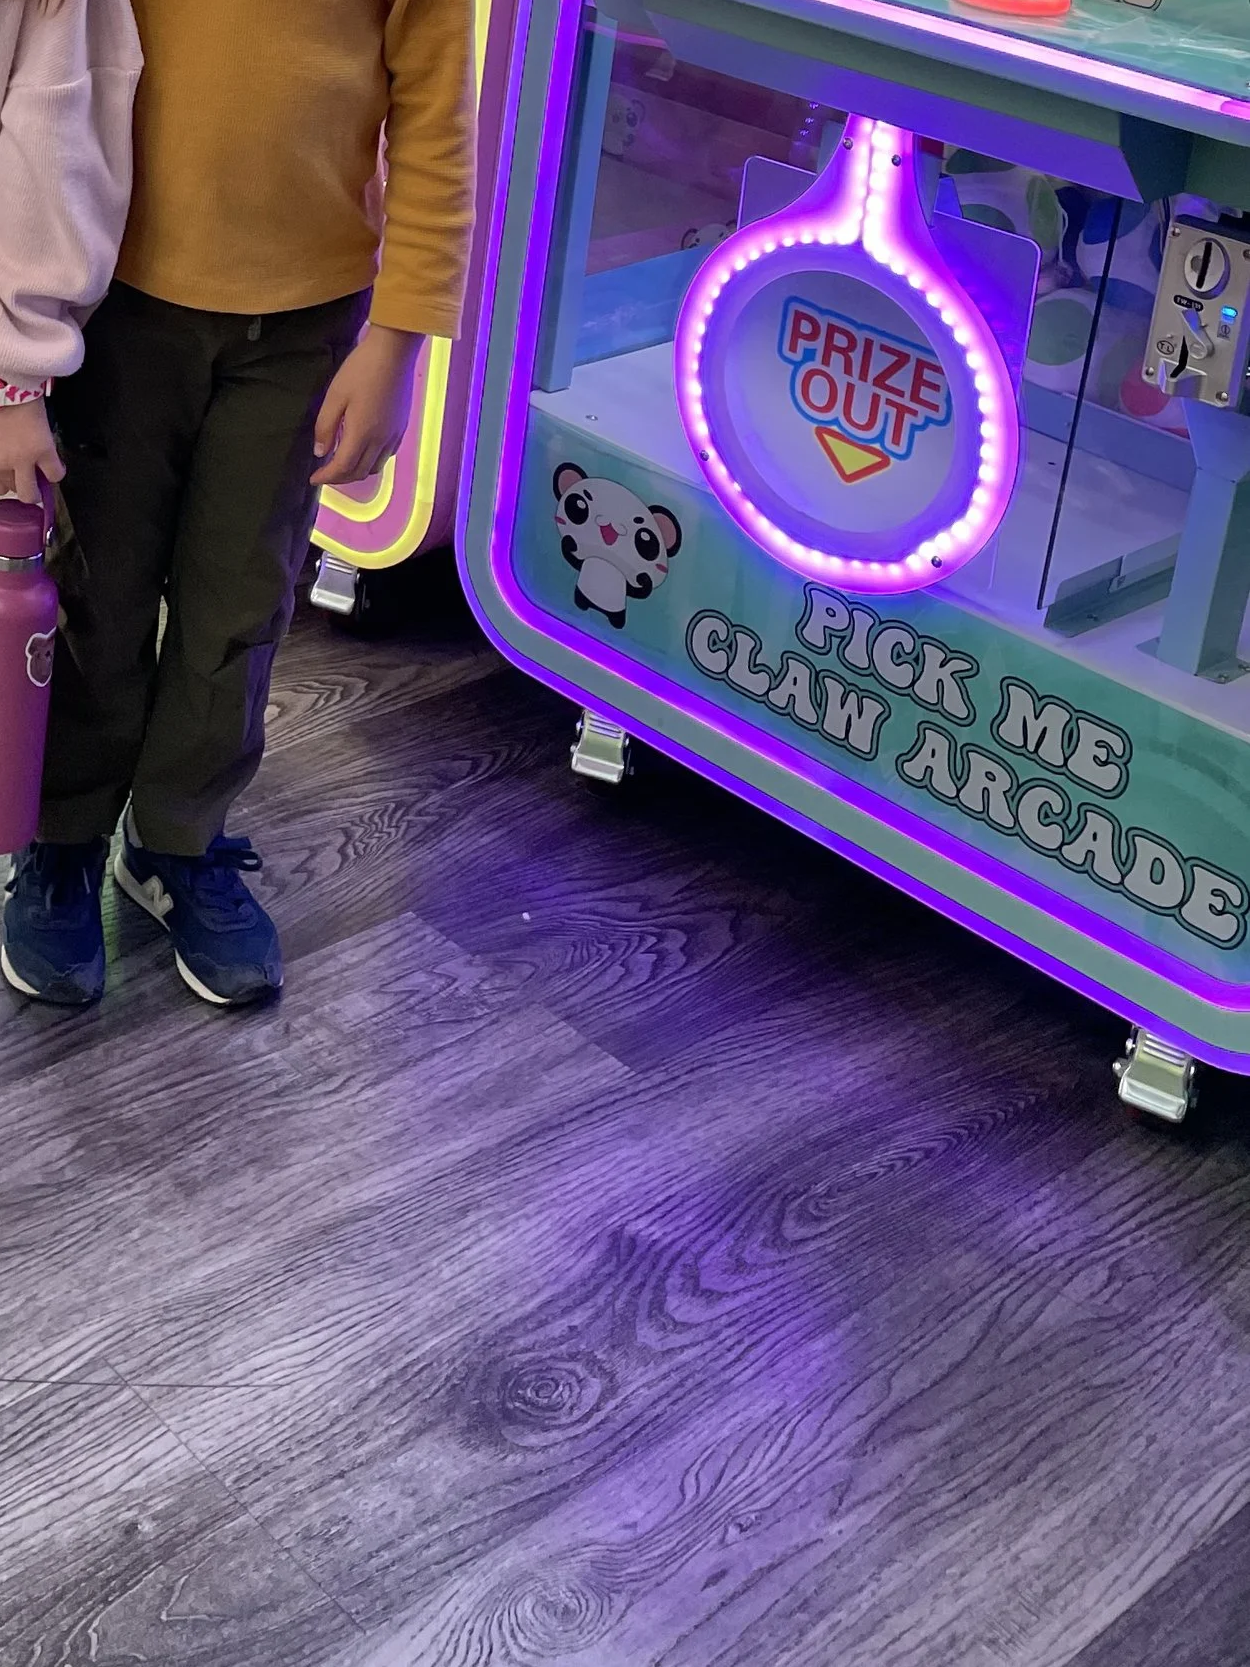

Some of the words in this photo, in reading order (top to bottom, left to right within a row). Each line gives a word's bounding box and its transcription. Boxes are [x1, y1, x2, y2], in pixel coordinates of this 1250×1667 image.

[788, 308, 946, 413] PRIZE
[801, 368, 919, 447] OUT
[799, 585, 977, 724] PICK
[994, 680, 1130, 795] ME
[688, 613, 888, 757] CLAW
[898, 726, 1247, 946] ARCADE
